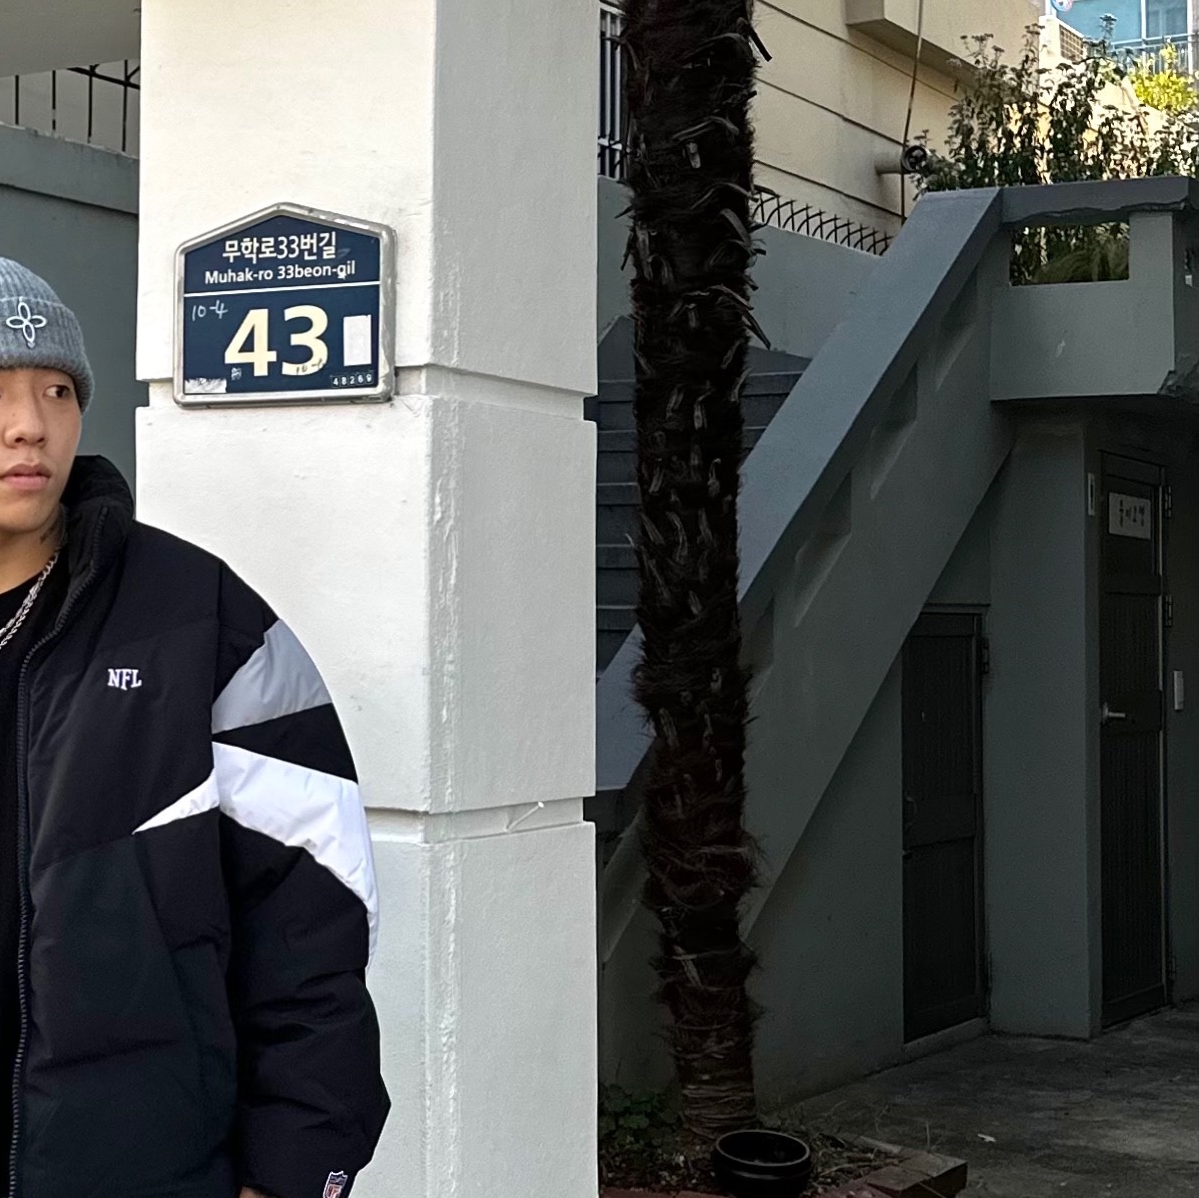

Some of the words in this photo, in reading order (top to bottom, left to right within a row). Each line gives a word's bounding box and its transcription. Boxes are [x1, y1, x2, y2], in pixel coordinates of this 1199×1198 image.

[222, 231, 337, 264] 무학로33번길
[204, 267, 274, 284] Muhak-ro
[277, 260, 355, 280] 33beon-gil
[191, 299, 228, 321] 10-4
[224, 304, 329, 377] 43
[107, 668, 142, 691] NFL
